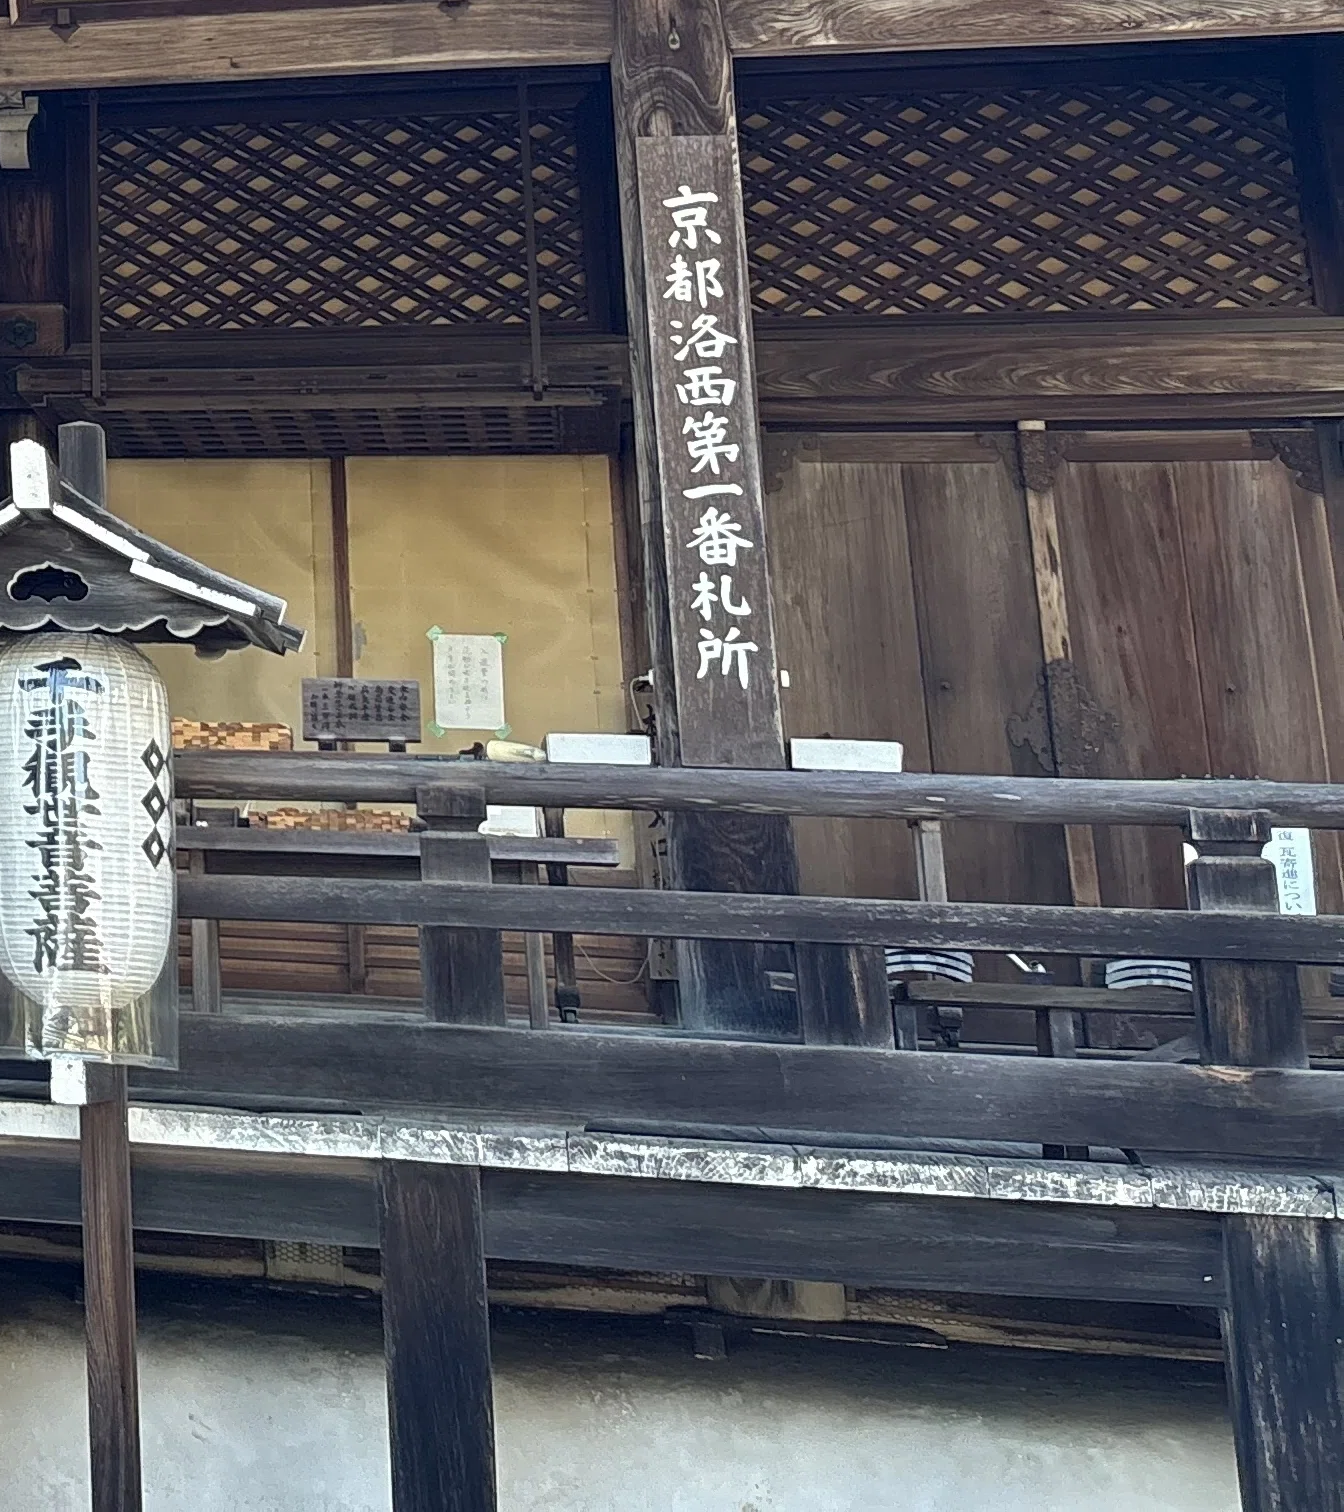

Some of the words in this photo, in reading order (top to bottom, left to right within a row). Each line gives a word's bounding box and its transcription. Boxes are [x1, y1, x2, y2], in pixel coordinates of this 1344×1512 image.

[662, 185, 758, 689] 京都洛西第一番札所
